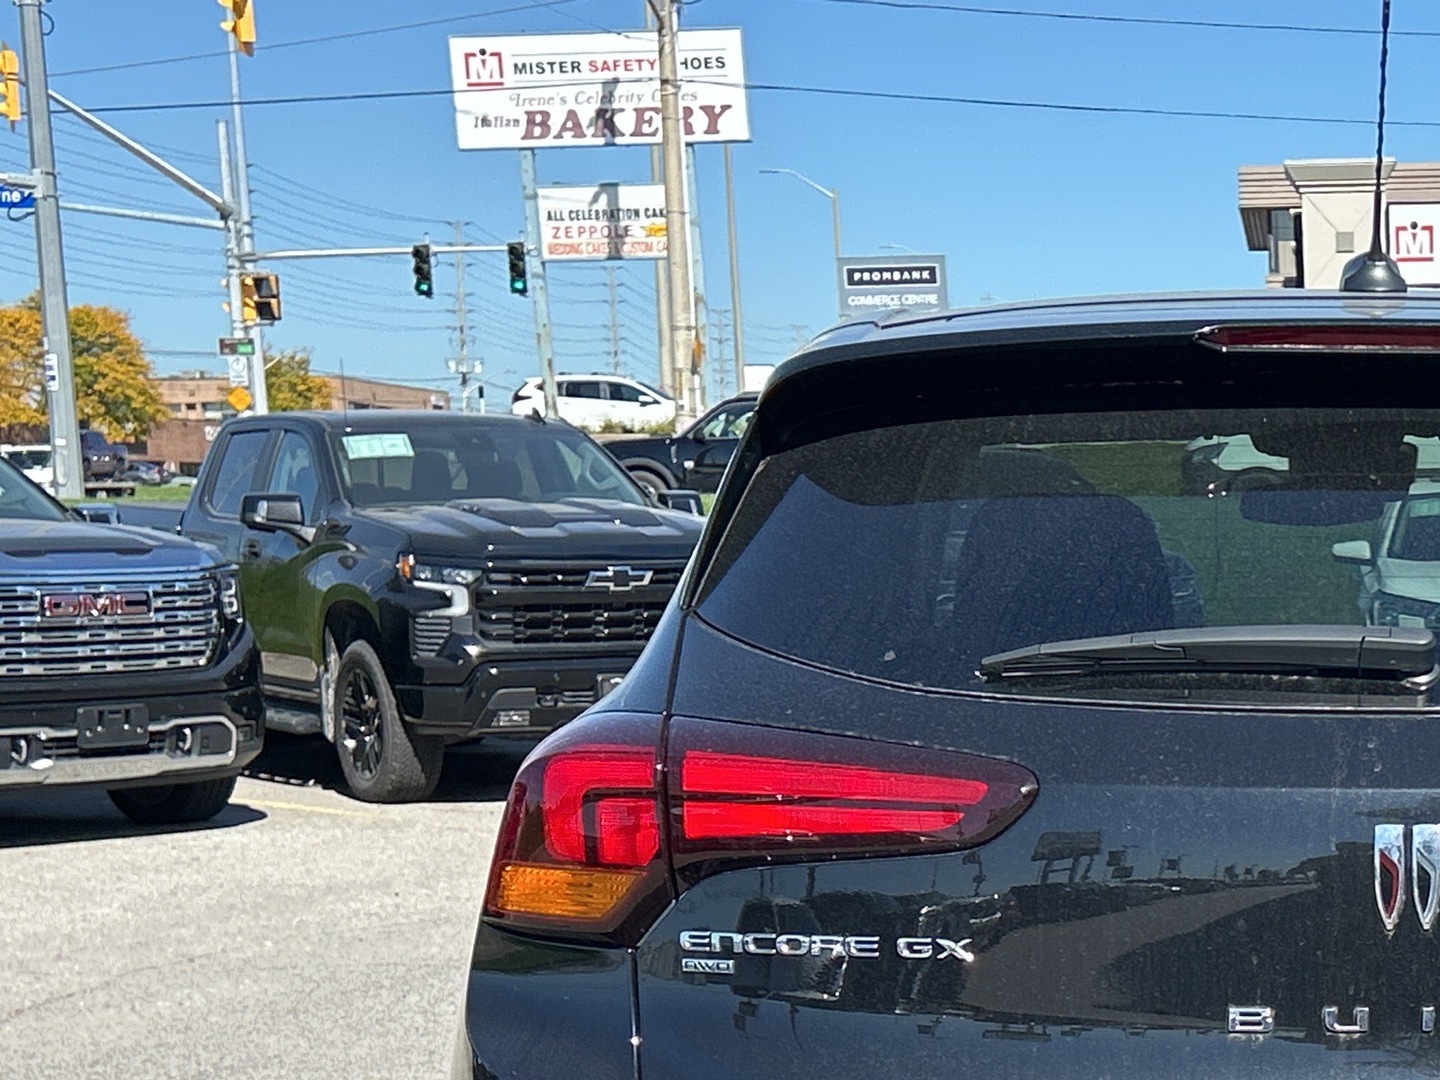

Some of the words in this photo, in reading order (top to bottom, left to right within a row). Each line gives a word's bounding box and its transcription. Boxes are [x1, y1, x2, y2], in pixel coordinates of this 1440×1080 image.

[513, 60, 582, 75] MISTER
[588, 58, 657, 74] SAFETY
[679, 56, 726, 70] HOES
[509, 92, 567, 107] Irene's
[574, 89, 644, 105] Celebrity
[651, 89, 698, 102] Ces
[547, 210, 565, 221] ALL
[568, 208, 640, 221] CELEBRATION
[551, 225, 634, 239] ZEPPOLE
[44, 593, 149, 616] GMC
[896, 937, 975, 962] GX
